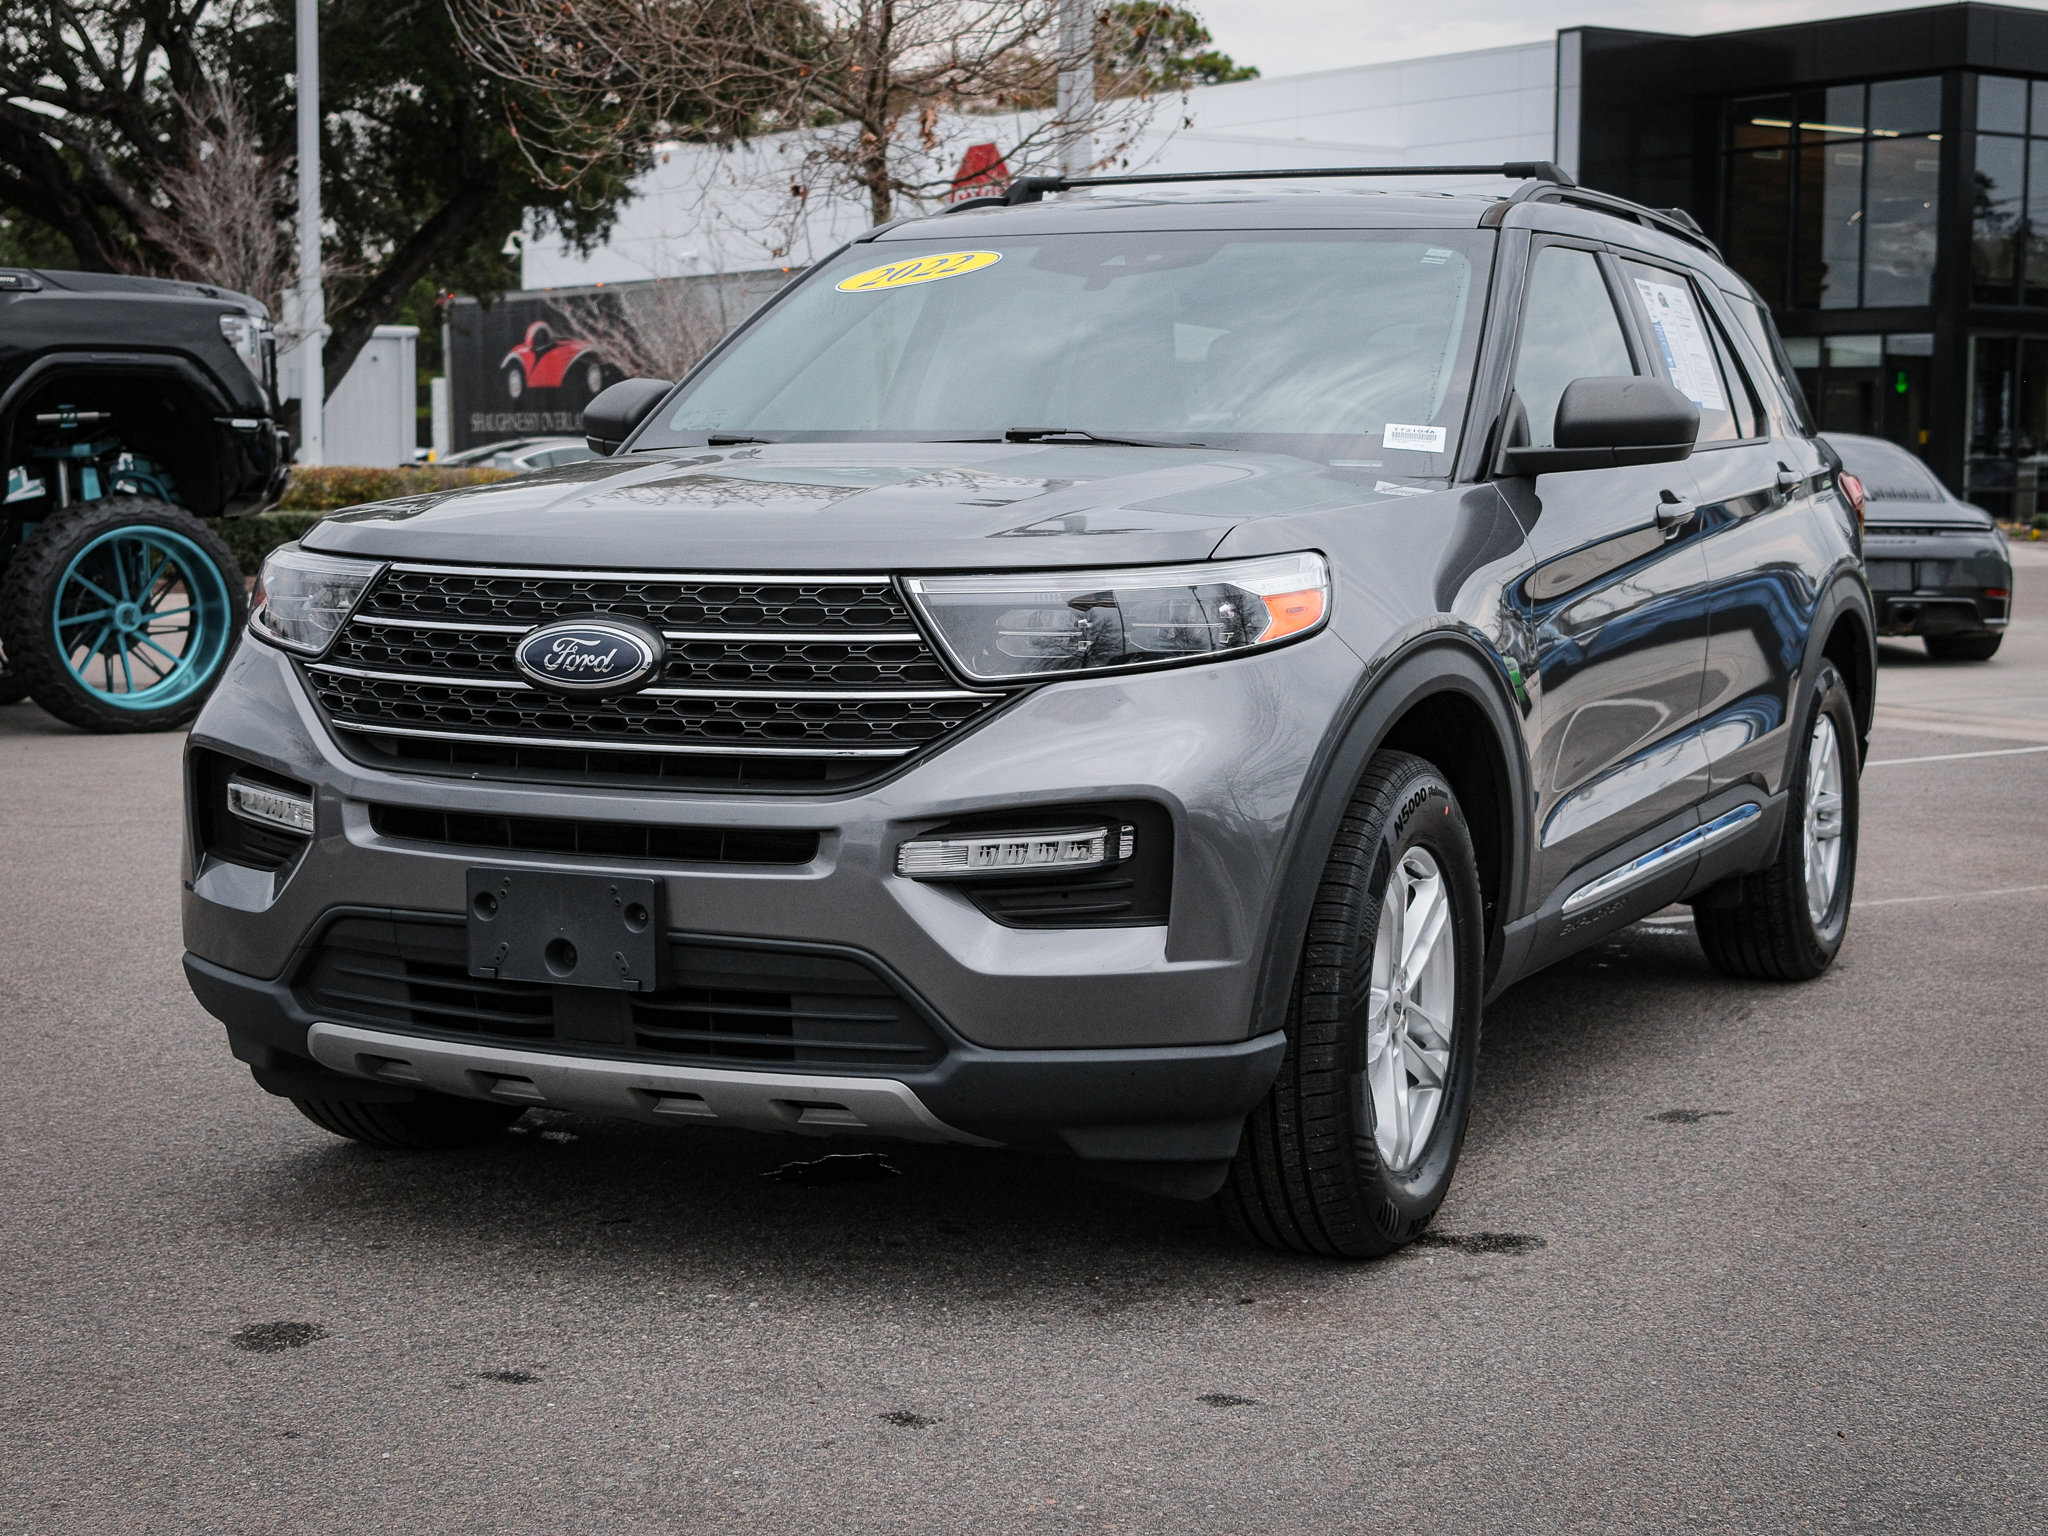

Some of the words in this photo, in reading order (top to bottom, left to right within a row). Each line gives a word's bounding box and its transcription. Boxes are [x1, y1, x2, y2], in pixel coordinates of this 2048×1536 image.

[856, 254, 975, 288] 2022
[542, 411, 585, 433] OVERLA
[543, 637, 618, 673] Ford
[1393, 787, 1427, 841] N5000
